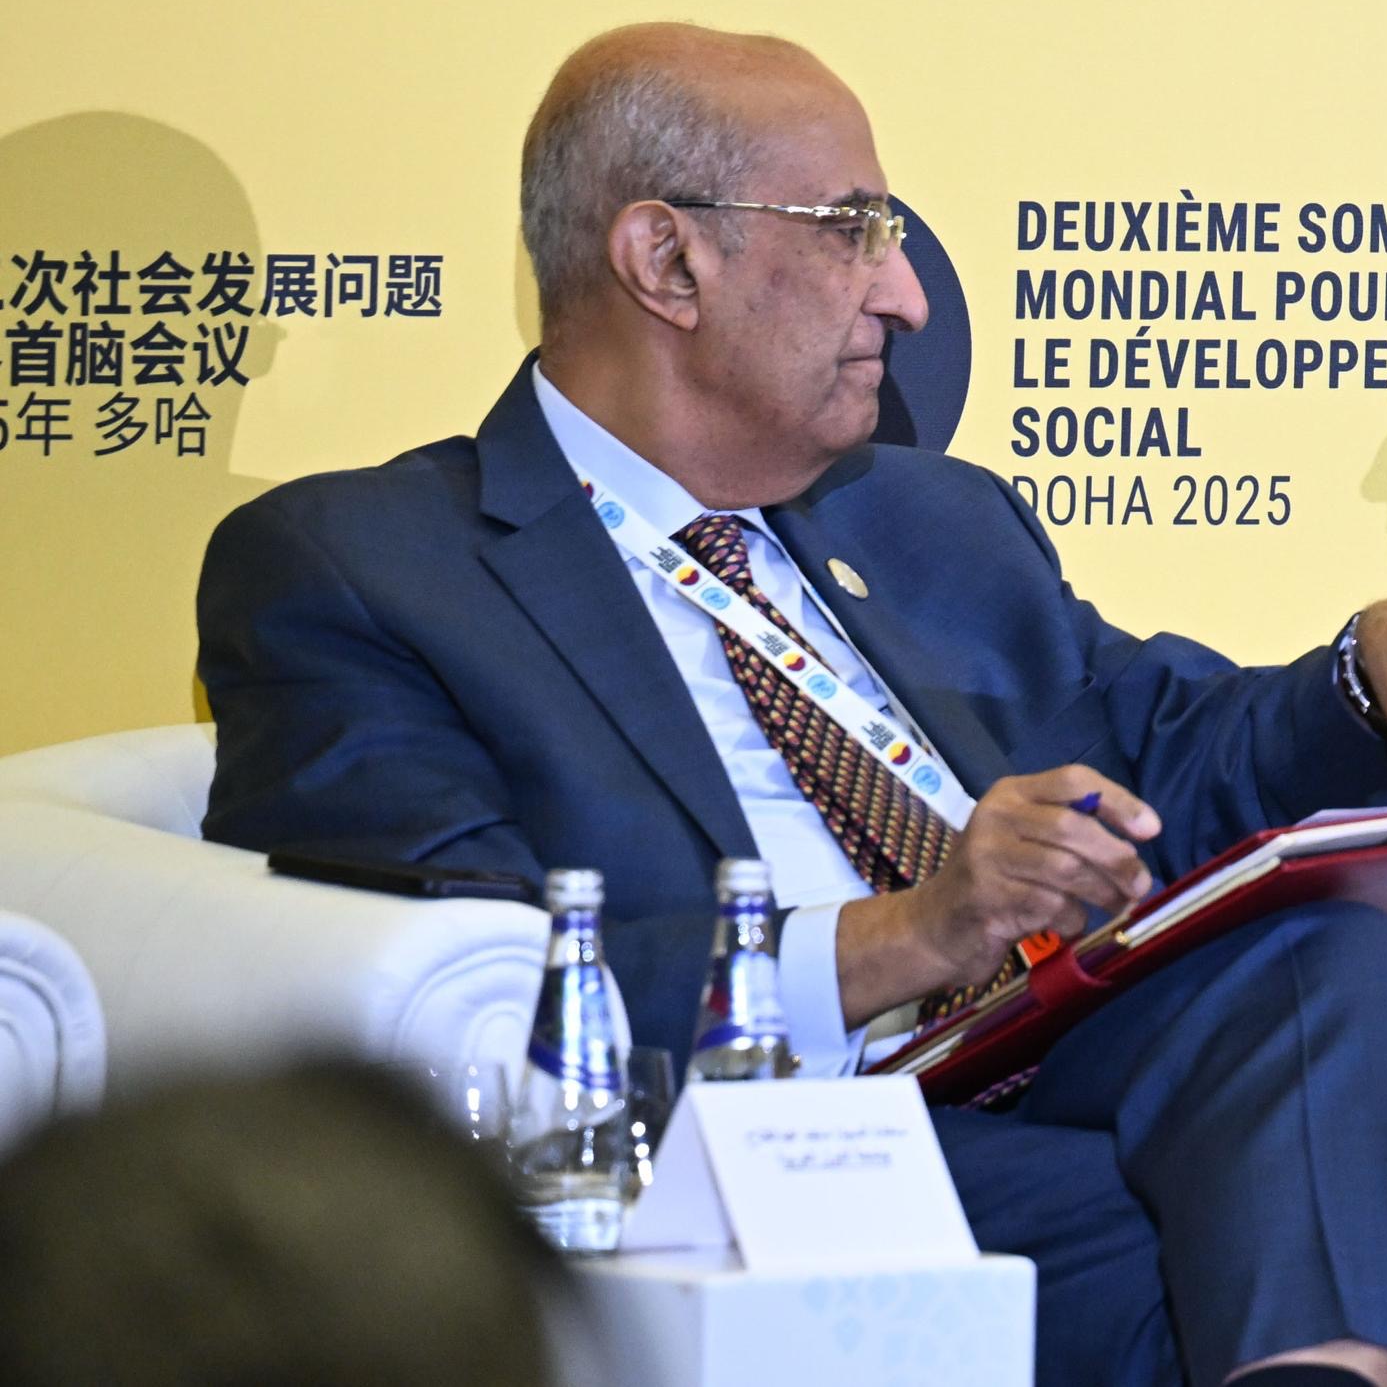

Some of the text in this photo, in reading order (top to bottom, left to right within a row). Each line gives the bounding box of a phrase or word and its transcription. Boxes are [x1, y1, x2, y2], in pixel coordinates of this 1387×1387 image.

[1017, 188, 1281, 253] DEUXIÈME
[0, 249, 444, 318] 次社会发展问题
[1015, 269, 1257, 321] MONDIAL
[1013, 338, 1072, 389] LE
[93, 391, 212, 457] 多哈
[1010, 406, 1202, 458] SOCIAL
[1172, 474, 1291, 526] 2025
